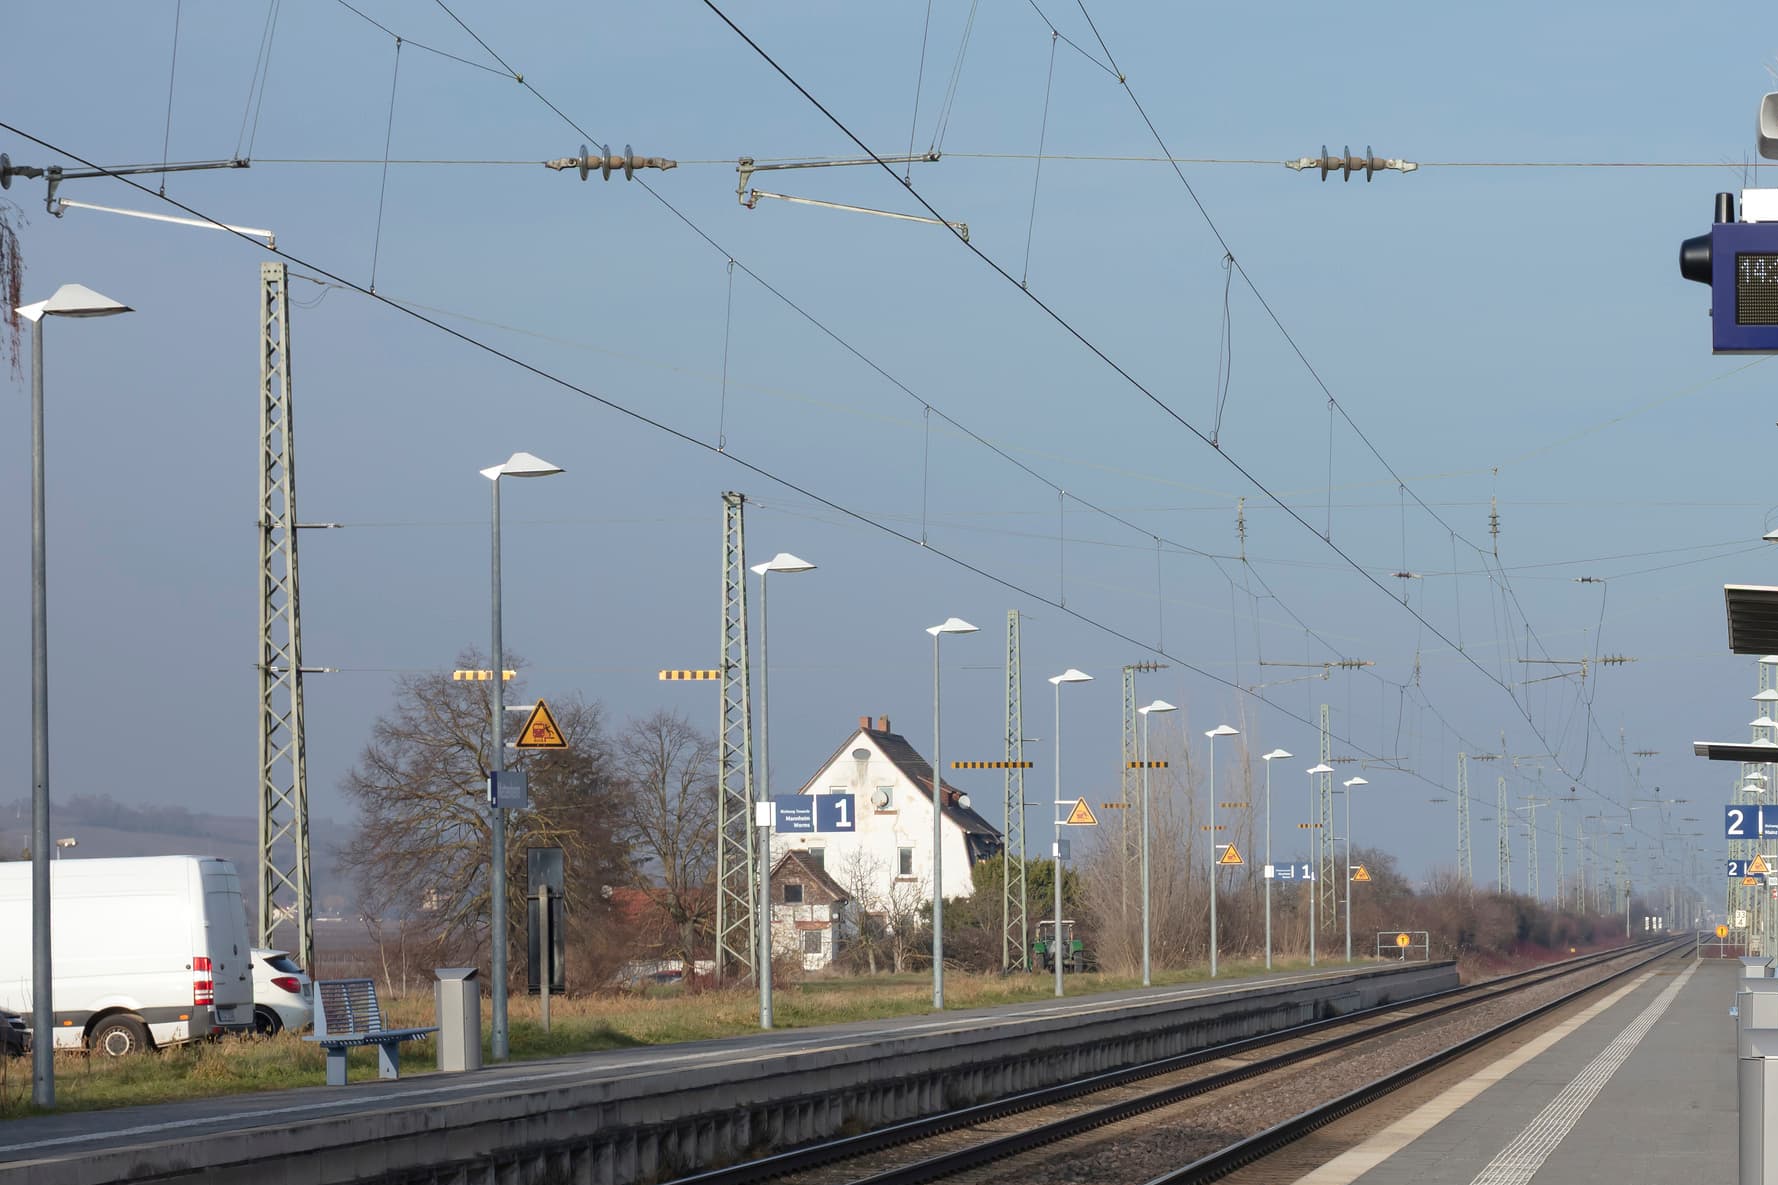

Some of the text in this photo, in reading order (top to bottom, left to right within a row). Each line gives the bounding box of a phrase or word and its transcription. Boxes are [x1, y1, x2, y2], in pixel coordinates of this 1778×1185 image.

[835, 799, 852, 827] 1
[1727, 809, 1744, 835] 2
[1302, 864, 1311, 879] 1
[1728, 862, 1738, 876] 2
